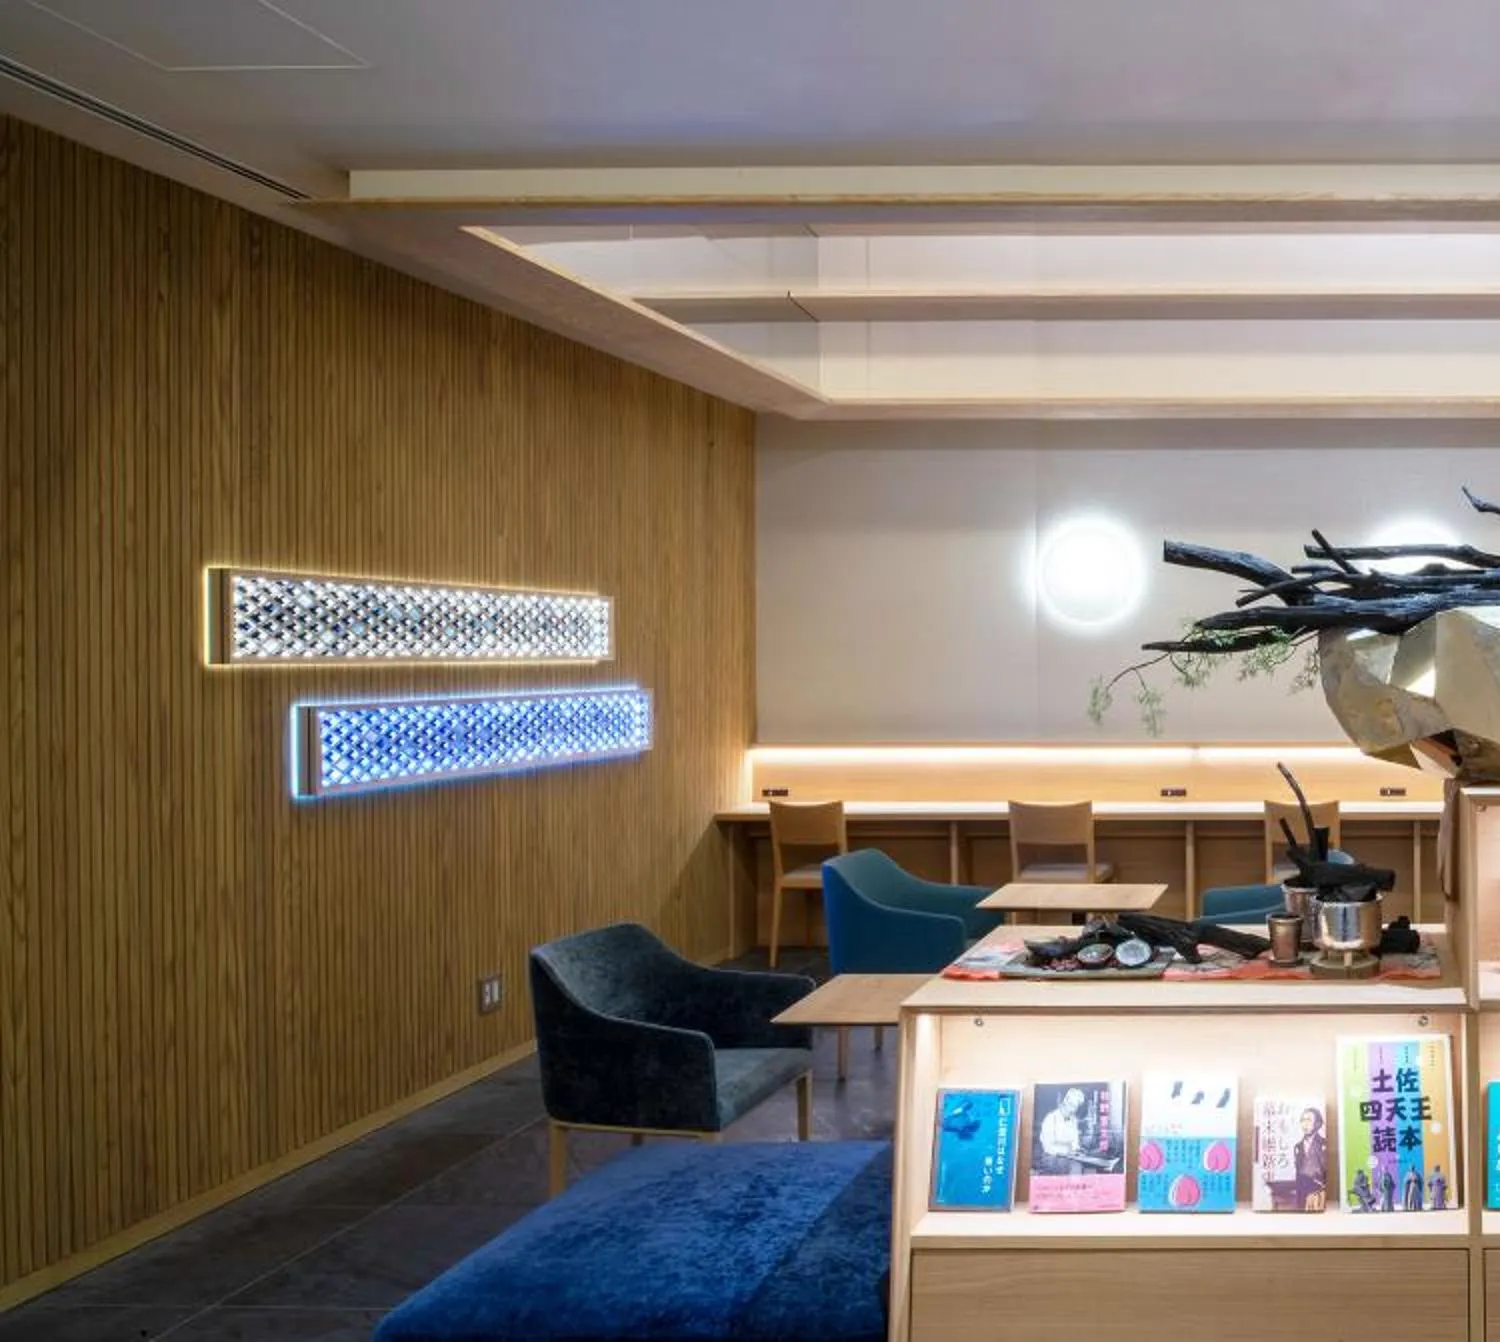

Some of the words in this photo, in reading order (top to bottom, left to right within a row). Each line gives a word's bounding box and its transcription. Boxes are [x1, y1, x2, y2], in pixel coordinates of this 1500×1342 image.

[1372, 1067, 1419, 1093] 土佐
[1360, 1096, 1432, 1121] 四天王
[1372, 1125, 1422, 1153] 読本
